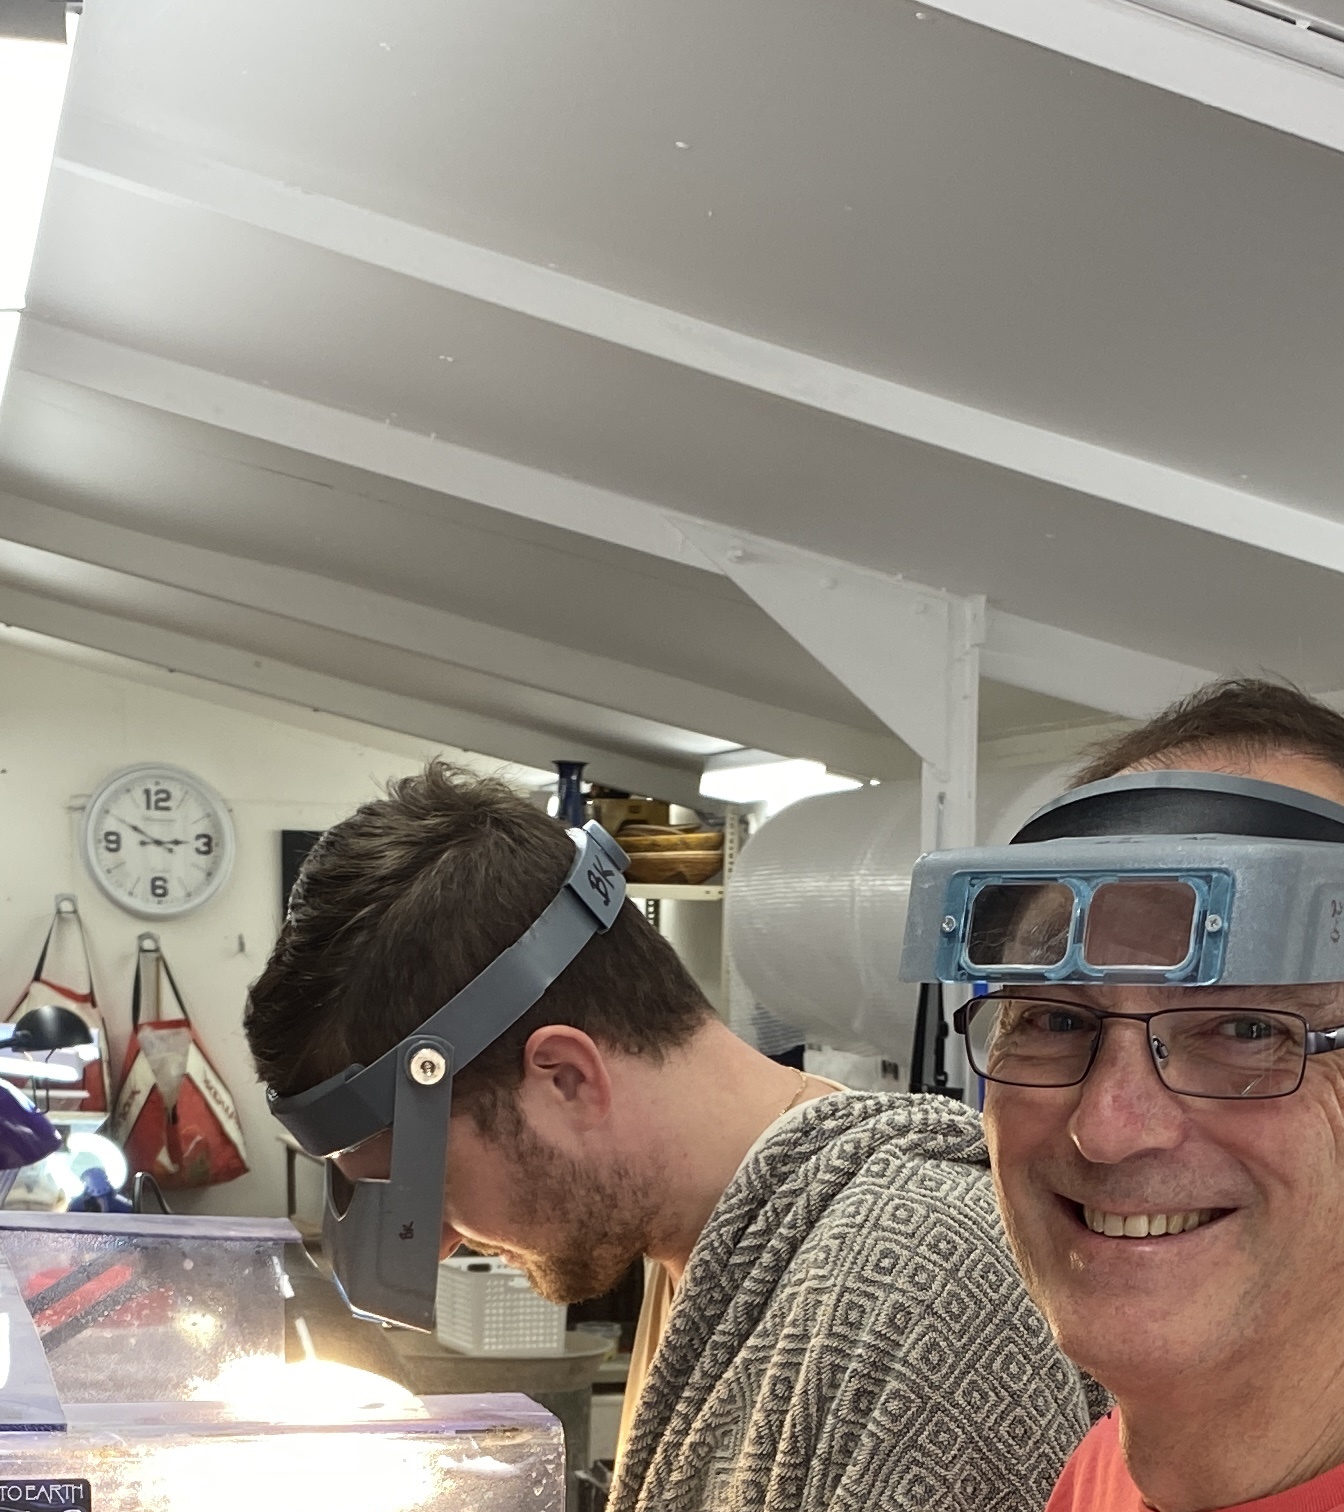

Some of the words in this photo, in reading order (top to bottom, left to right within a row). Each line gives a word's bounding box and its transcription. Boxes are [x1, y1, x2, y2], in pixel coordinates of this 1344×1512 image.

[143, 788, 172, 811] 12
[104, 831, 122, 853] 9
[194, 833, 213, 855] 3
[150, 876, 169, 898] 6
[25, 1484, 84, 1504] EARTH
